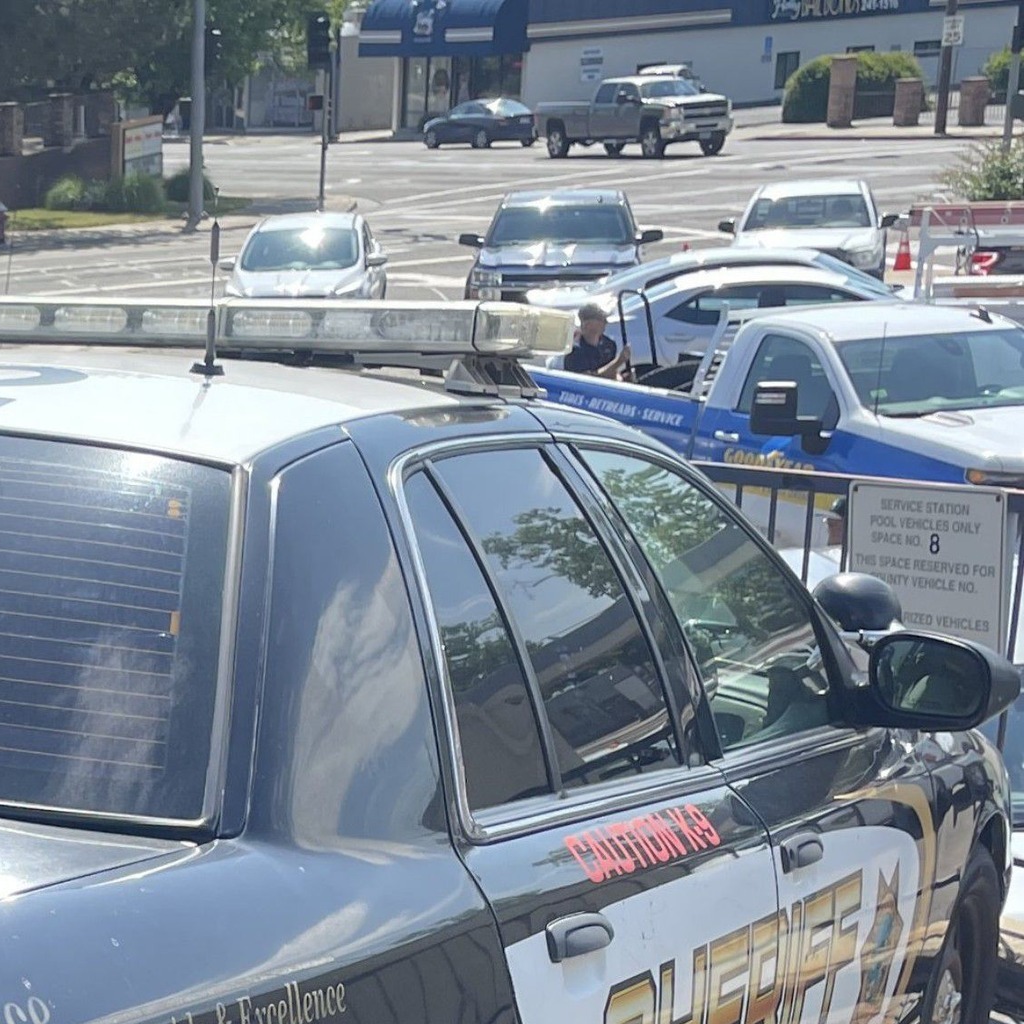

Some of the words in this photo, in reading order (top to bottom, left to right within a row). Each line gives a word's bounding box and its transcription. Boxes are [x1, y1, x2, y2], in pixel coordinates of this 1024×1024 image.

[559, 390, 585, 406] TIRES
[588, 397, 637, 418] RETREADS
[642, 407, 684, 427] SERVICE
[880, 498, 923, 512] SERVICE
[925, 502, 970, 516] STATION
[870, 515, 897, 528] POOL
[900, 517, 950, 533] VEHICLES
[952, 521, 981, 535] ONLY
[871, 531, 902, 545] SPACE
[905, 535, 923, 548] NO.
[929, 533, 940, 555] 8
[855, 553, 877, 566] THIS
[879, 555, 911, 570] SPACE
[913, 558, 969, 576] RESERVED
[972, 564, 996, 578] FOR
[911, 576, 955, 590] VEHICLE
[958, 581, 978, 594] NO.
[936, 614, 990, 632] VEHICLES
[564, 812, 687, 884] CAUTION
[666, 802, 721, 852] K-9
